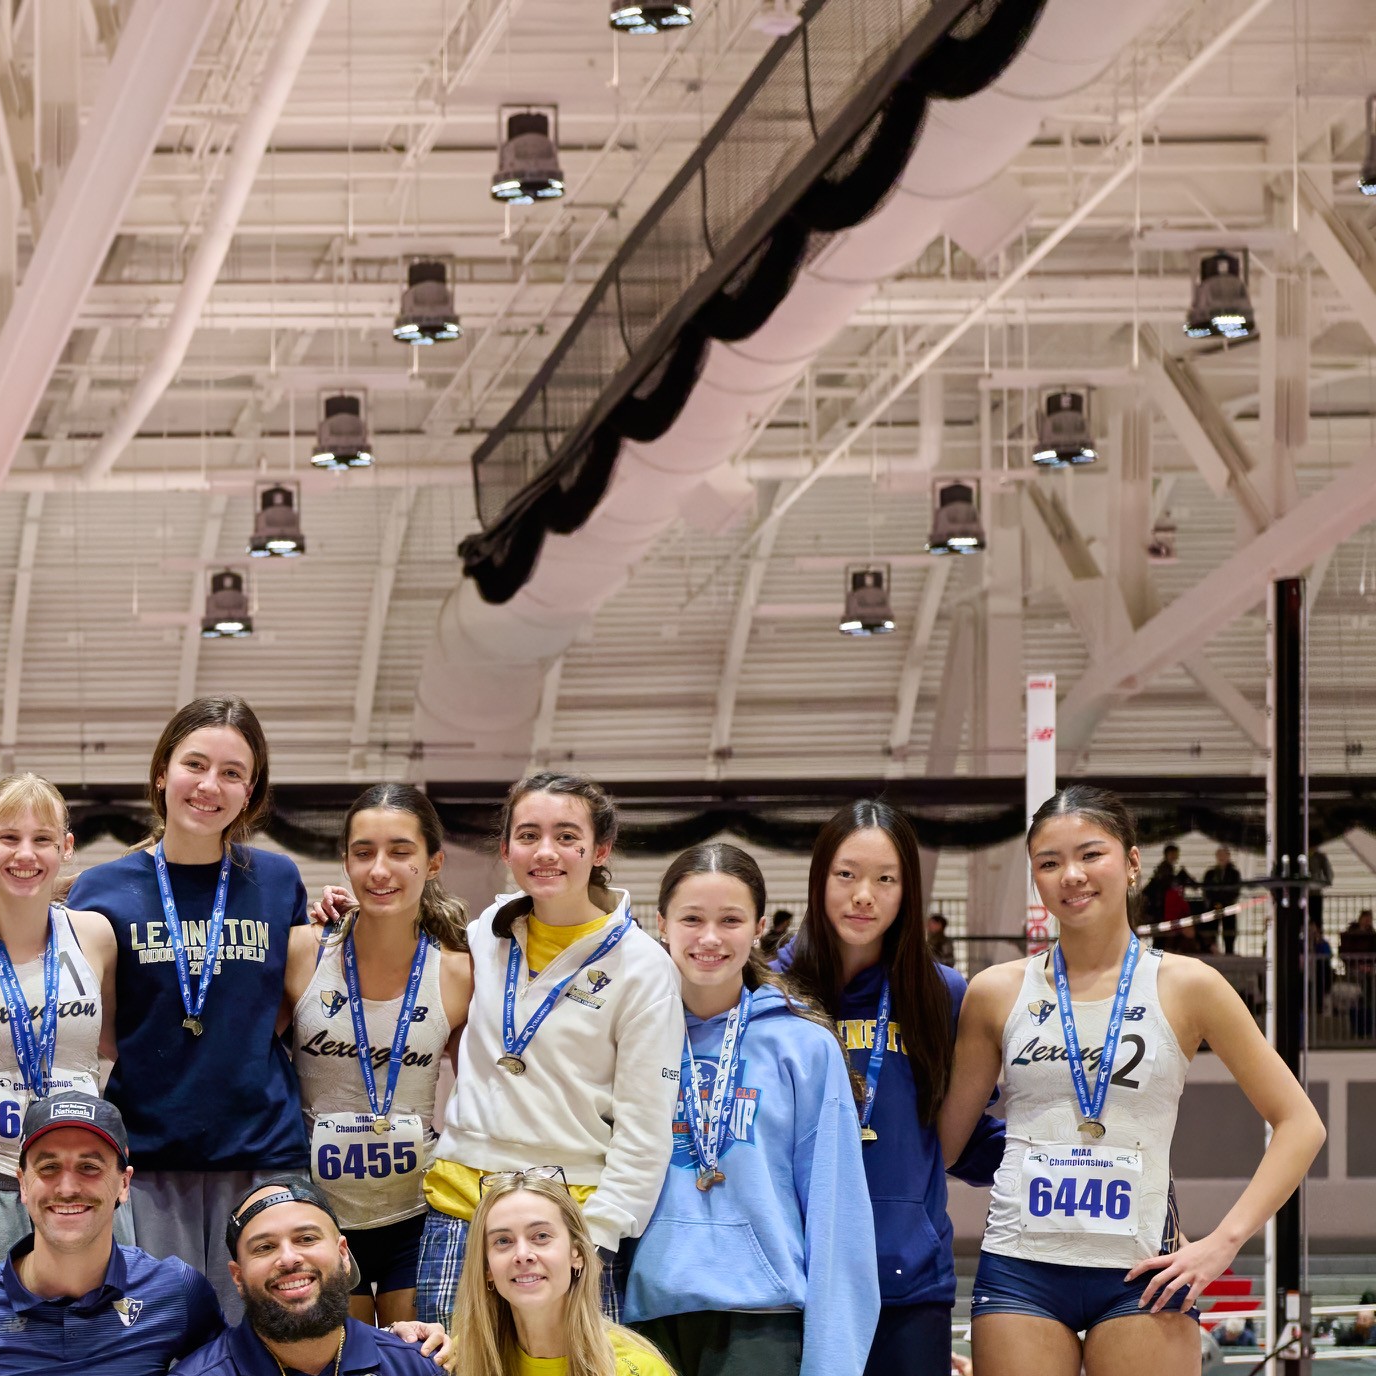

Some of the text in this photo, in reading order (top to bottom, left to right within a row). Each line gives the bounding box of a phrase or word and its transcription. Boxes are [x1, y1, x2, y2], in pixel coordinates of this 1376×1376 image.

[130, 919, 269, 950] LEINTON
[139, 945, 265, 964] INDOO TRAK & FIELD
[189, 961, 222, 976] 205
[301, 1030, 433, 1070] Lexigon
[1011, 1037, 1106, 1071] Lexing
[1110, 1034, 1146, 1089] 2
[13, 1080, 73, 1091] Chanships
[1077, 1077, 1087, 1105] CHAMPION
[318, 1141, 418, 1181] 6455
[1049, 1157, 1113, 1168] Championships
[1071, 1148, 1092, 1157] MIAA
[1029, 1177, 1132, 1220] 6446
